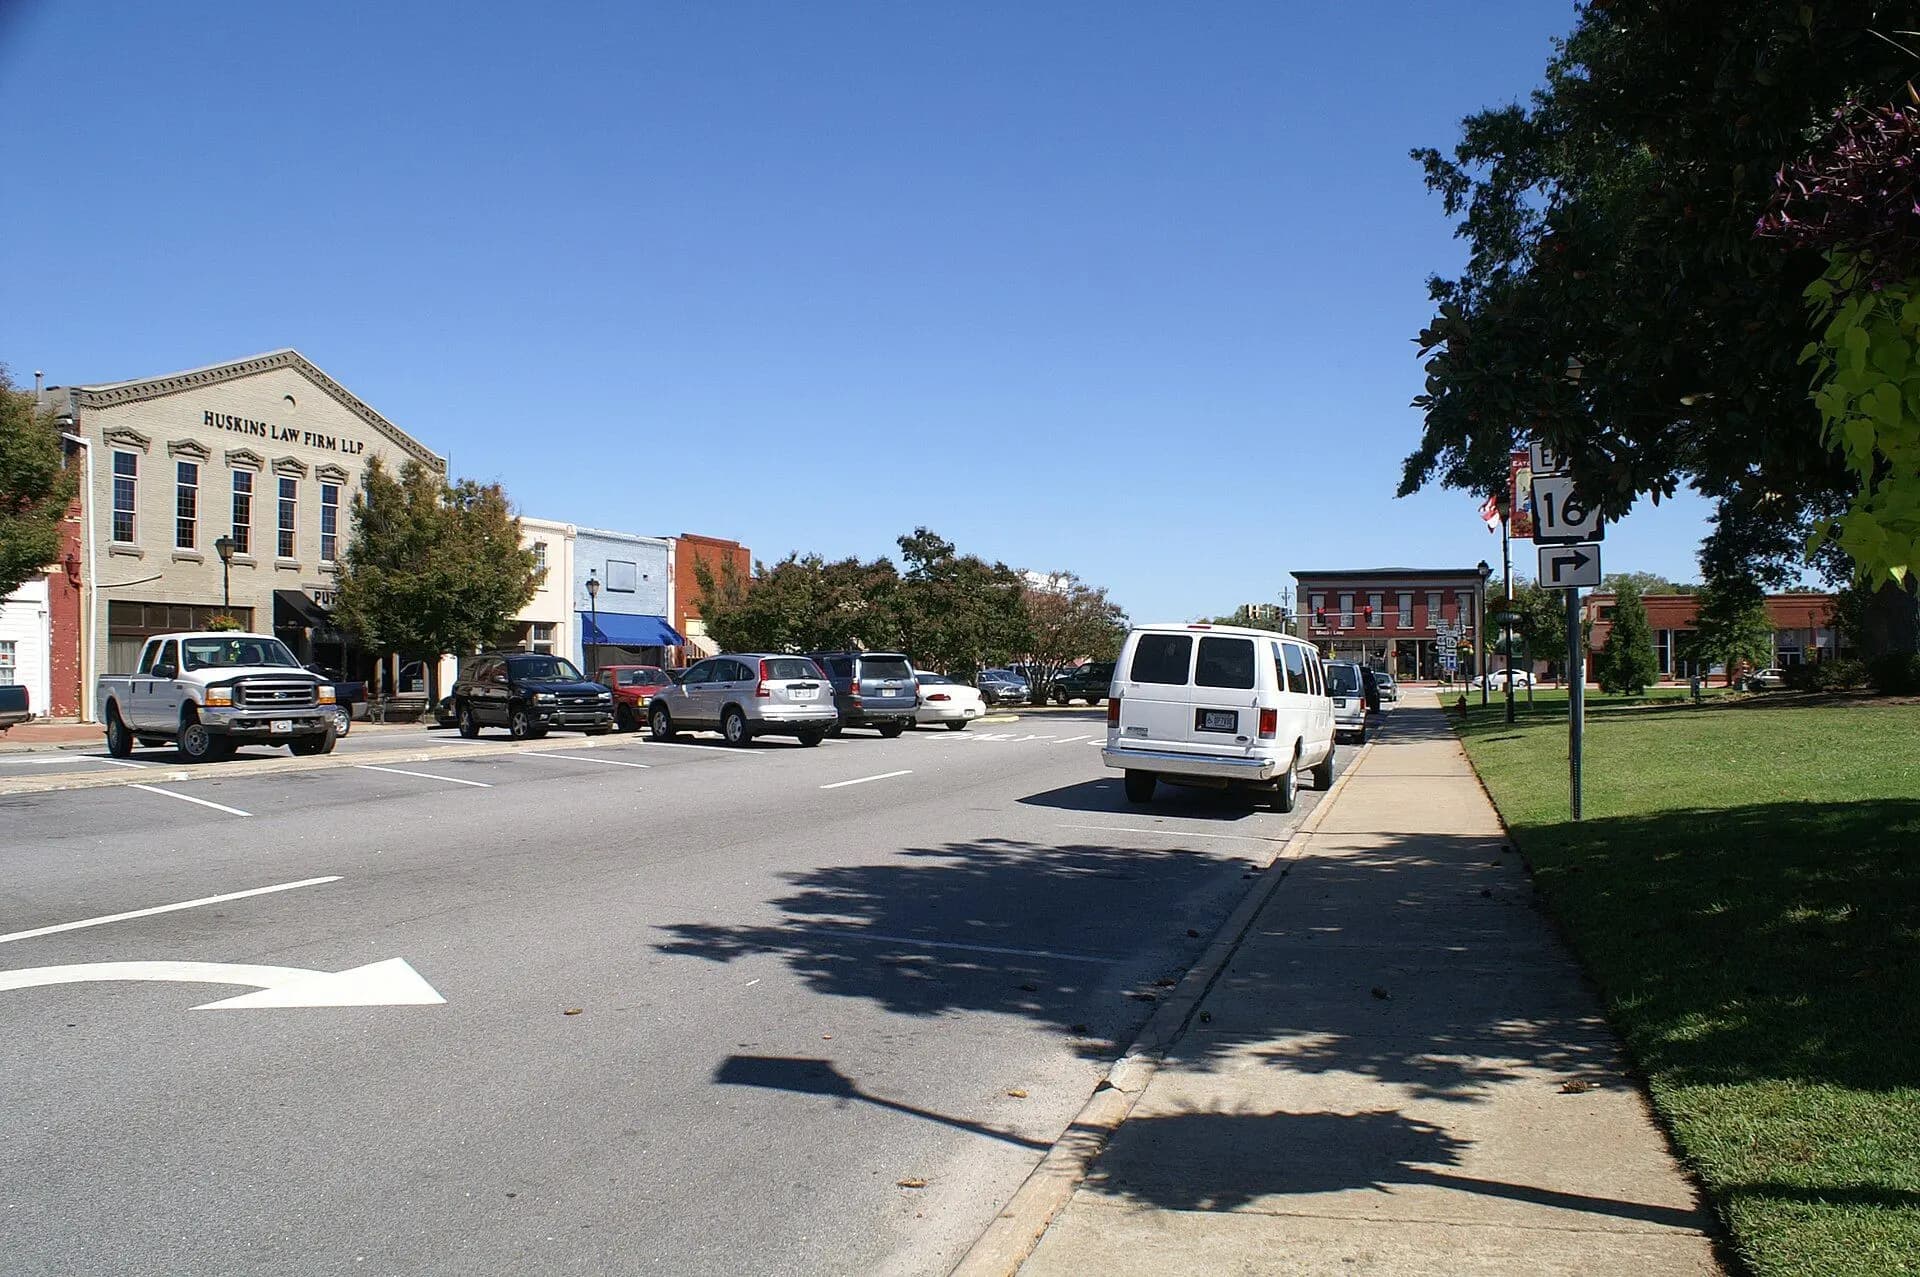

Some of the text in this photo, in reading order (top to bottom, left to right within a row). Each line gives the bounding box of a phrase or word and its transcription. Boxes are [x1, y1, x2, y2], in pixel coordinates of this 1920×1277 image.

[204, 410, 364, 455] HUSKINS LAW FIRM LLP
[1543, 490, 1587, 528] 16
[314, 590, 337, 605] PUT
